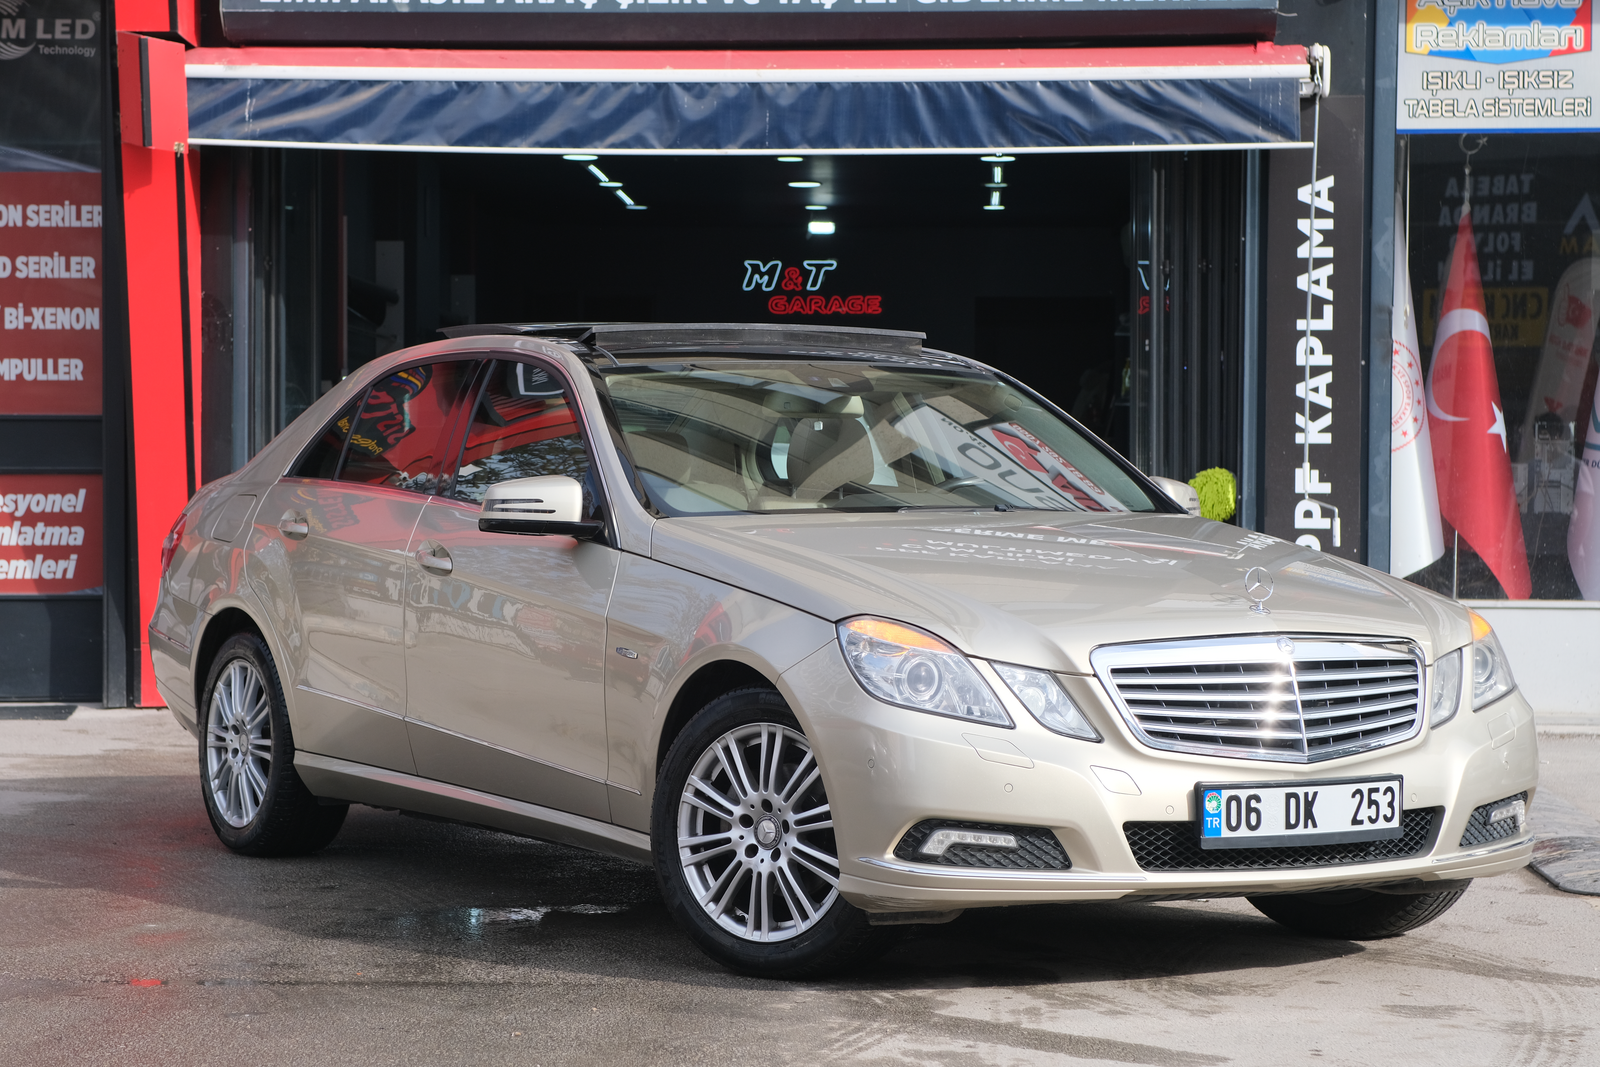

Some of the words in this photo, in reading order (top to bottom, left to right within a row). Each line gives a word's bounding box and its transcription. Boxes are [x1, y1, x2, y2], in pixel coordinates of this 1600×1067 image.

[36, 18, 96, 39] LED
[1415, 21, 1583, 50] Reklamları
[38, 44, 96, 57] Technology
[1422, 70, 1481, 96] IŞIKLI
[1498, 70, 1574, 96] IŞIKSIZ
[1404, 98, 1479, 118] TABELA
[1482, 96, 1591, 118] SİSTEMLERİ
[26, 200, 102, 228] SERİLER
[15, 251, 96, 279] SERİLER
[4, 302, 100, 330] Bİ-XENON
[768, 295, 882, 315] GARAGE
[1295, 175, 1334, 444] KAPLAMA
[1225, 793, 1262, 832] 06
[1285, 791, 1319, 830] DK
[1351, 786, 1396, 826] 253
[1206, 817, 1220, 829] TR
